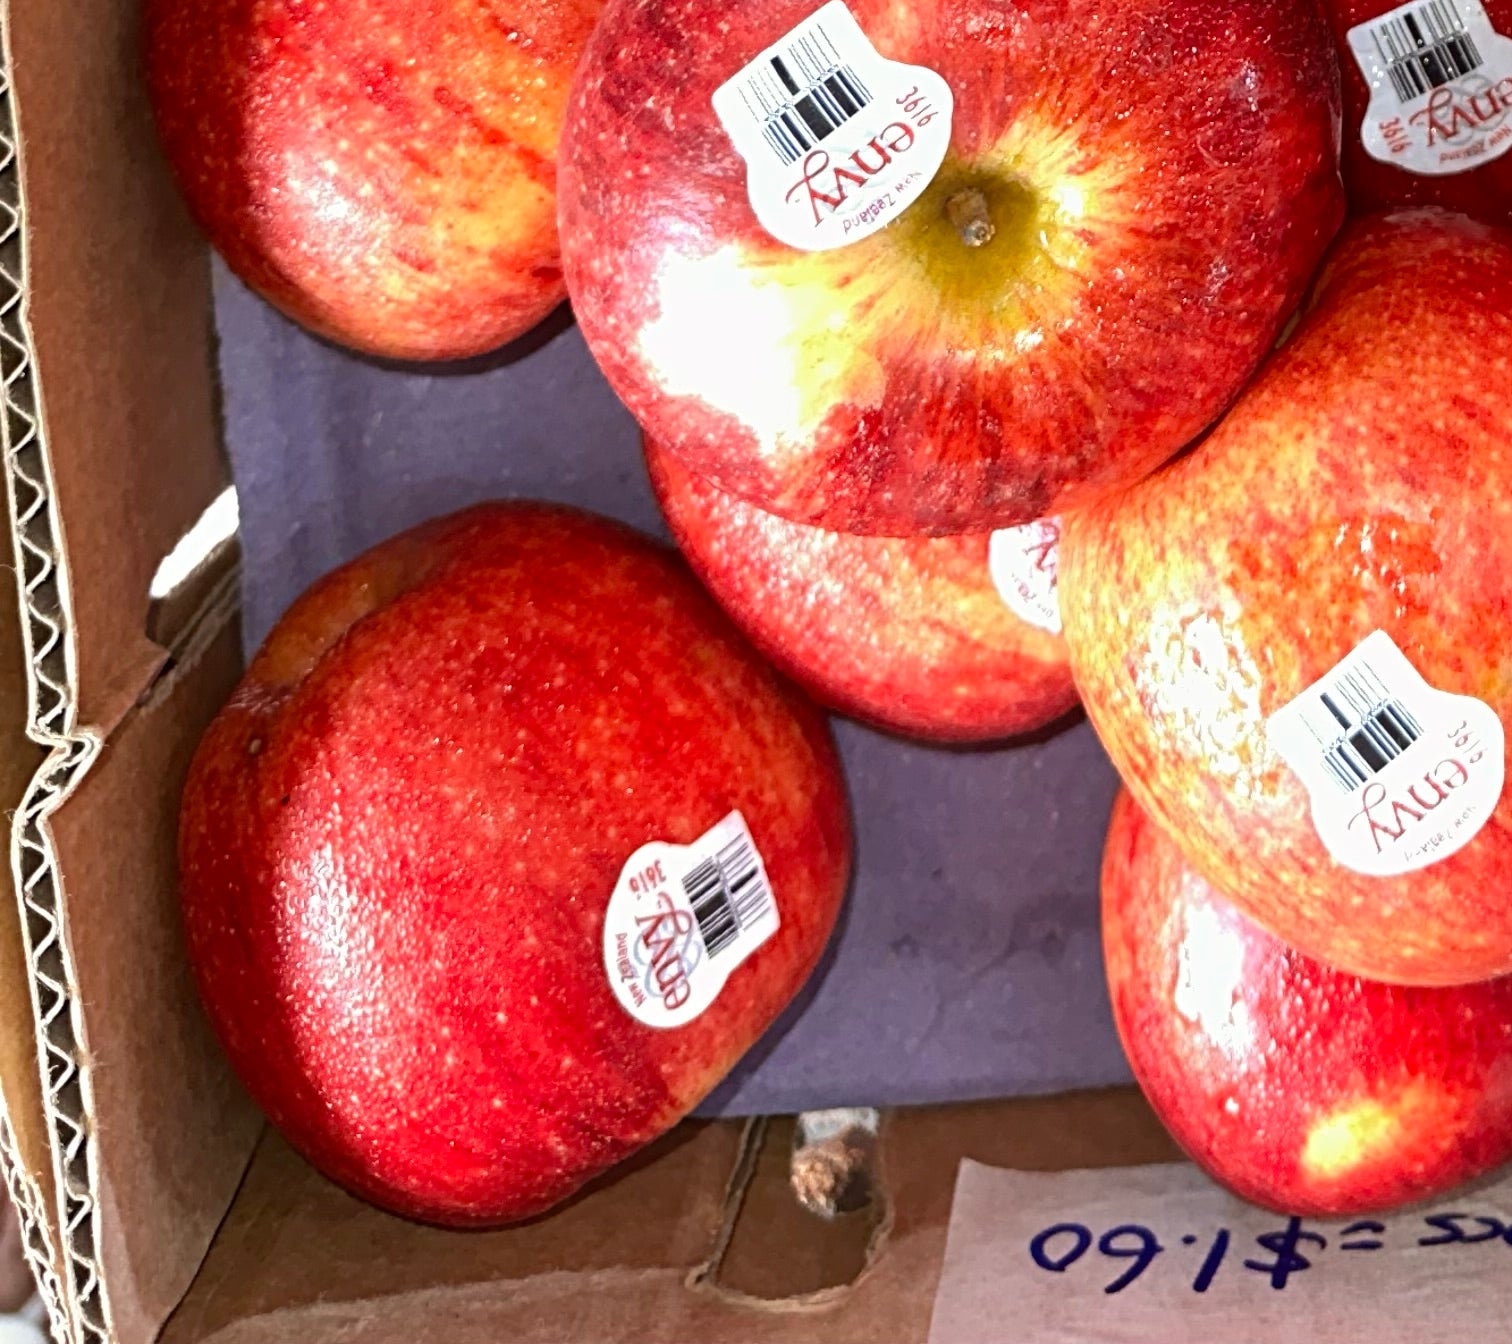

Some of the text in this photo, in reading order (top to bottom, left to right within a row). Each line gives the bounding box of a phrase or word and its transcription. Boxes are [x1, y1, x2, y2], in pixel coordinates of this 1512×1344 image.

[895, 85, 939, 128] 3616
[1378, 115, 1414, 155] 3616
[784, 120, 916, 229] envy
[1447, 719, 1489, 765] 3616
[1346, 757, 1470, 855] envy
[627, 858, 668, 900] 3616
[633, 889, 694, 1011] envy
[627, 982, 649, 1009] New
